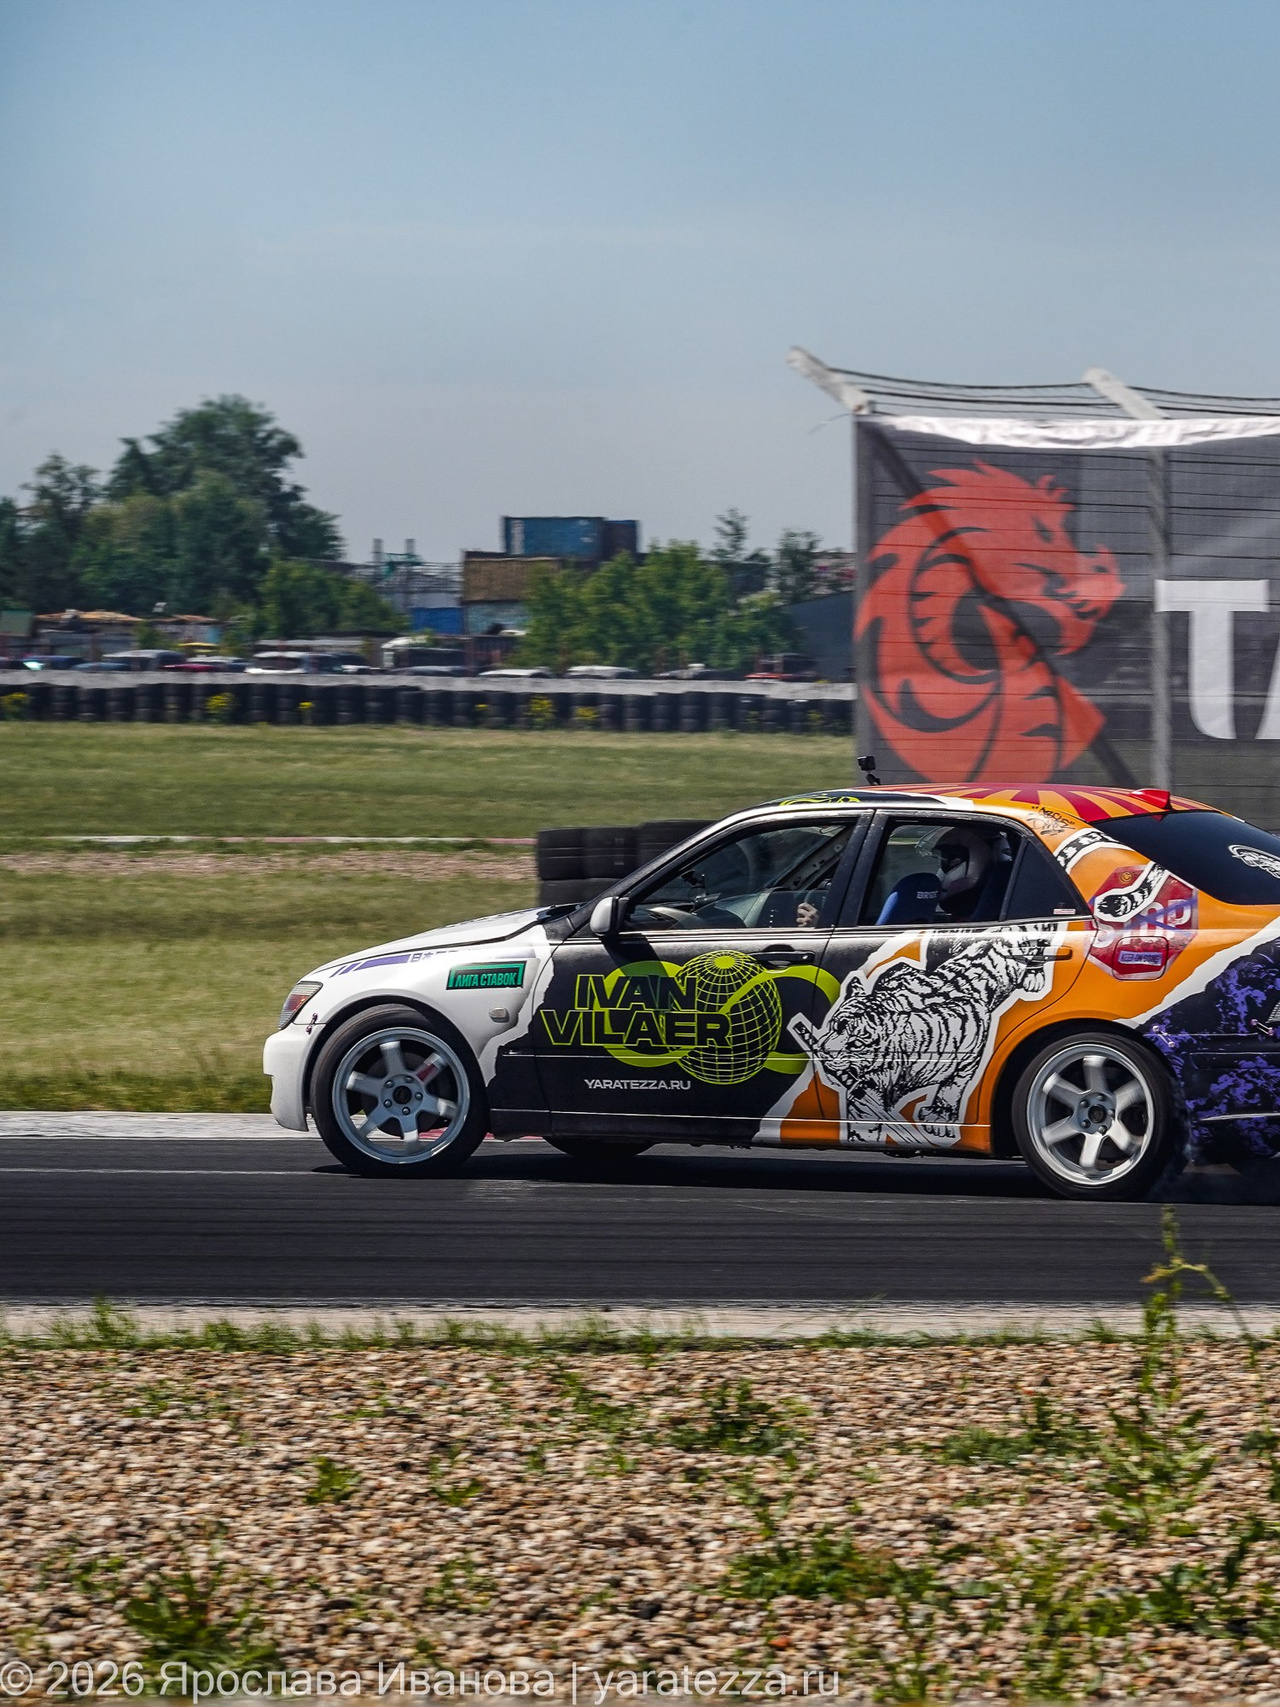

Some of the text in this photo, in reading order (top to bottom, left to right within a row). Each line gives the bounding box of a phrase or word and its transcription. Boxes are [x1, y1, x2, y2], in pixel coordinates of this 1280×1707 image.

[455, 972, 517, 987] ЛИГА СТАВОК
[574, 974, 699, 1011] IVAN
[539, 1009, 732, 1049] VILAER
[584, 1079, 691, 1091] YARATEZZA.RU
